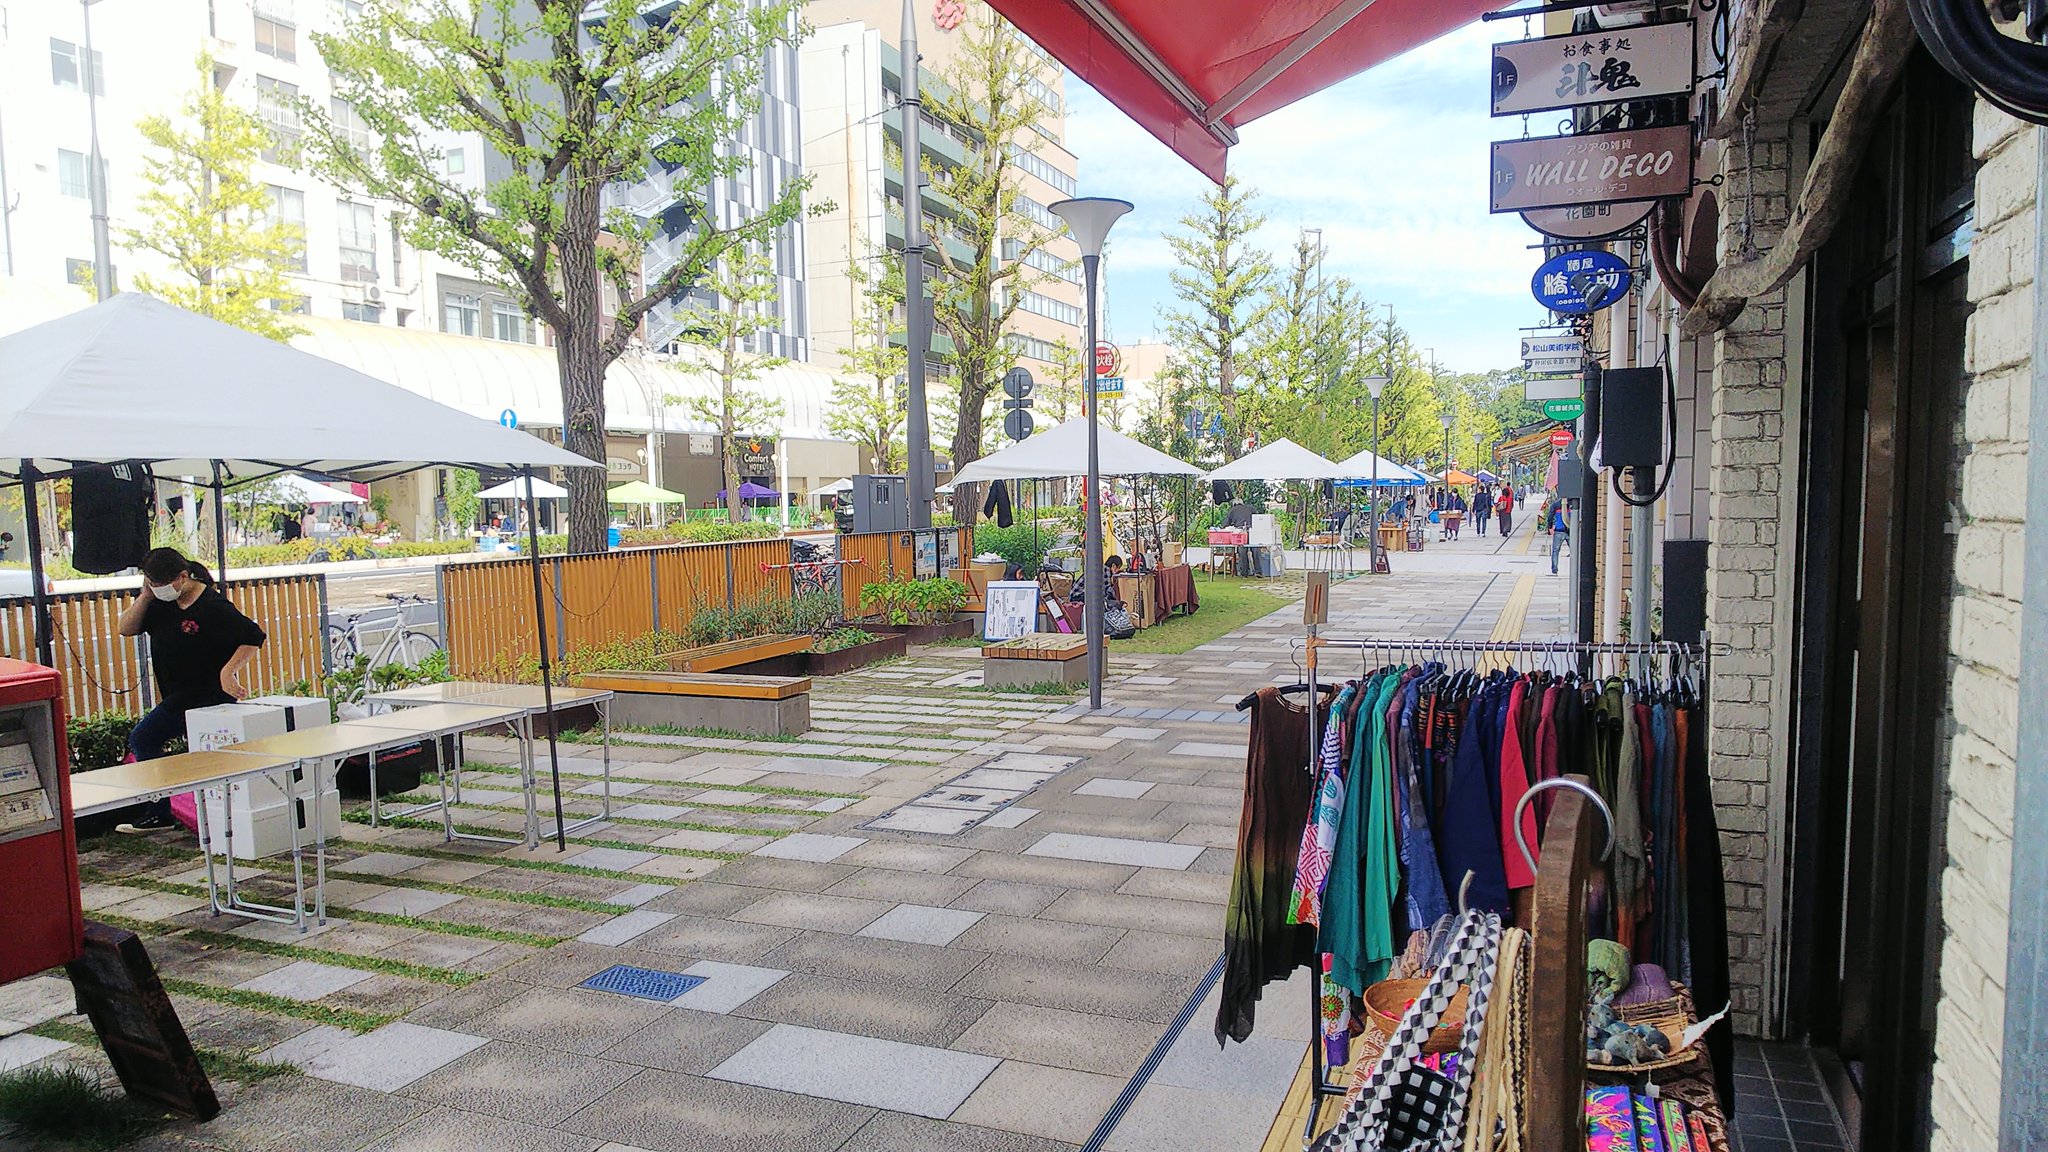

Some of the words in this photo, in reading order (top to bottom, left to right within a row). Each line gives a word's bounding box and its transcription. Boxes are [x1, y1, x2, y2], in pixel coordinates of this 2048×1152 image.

[1562, 38, 1632, 58] お食事処
[1567, 138, 1633, 155] アジアの雑貨
[1525, 158, 1590, 187] WALL
[1599, 150, 1674, 181] DECO
[1532, 342, 1580, 352] 松山美術学院
[743, 453, 769, 463] Comfort
